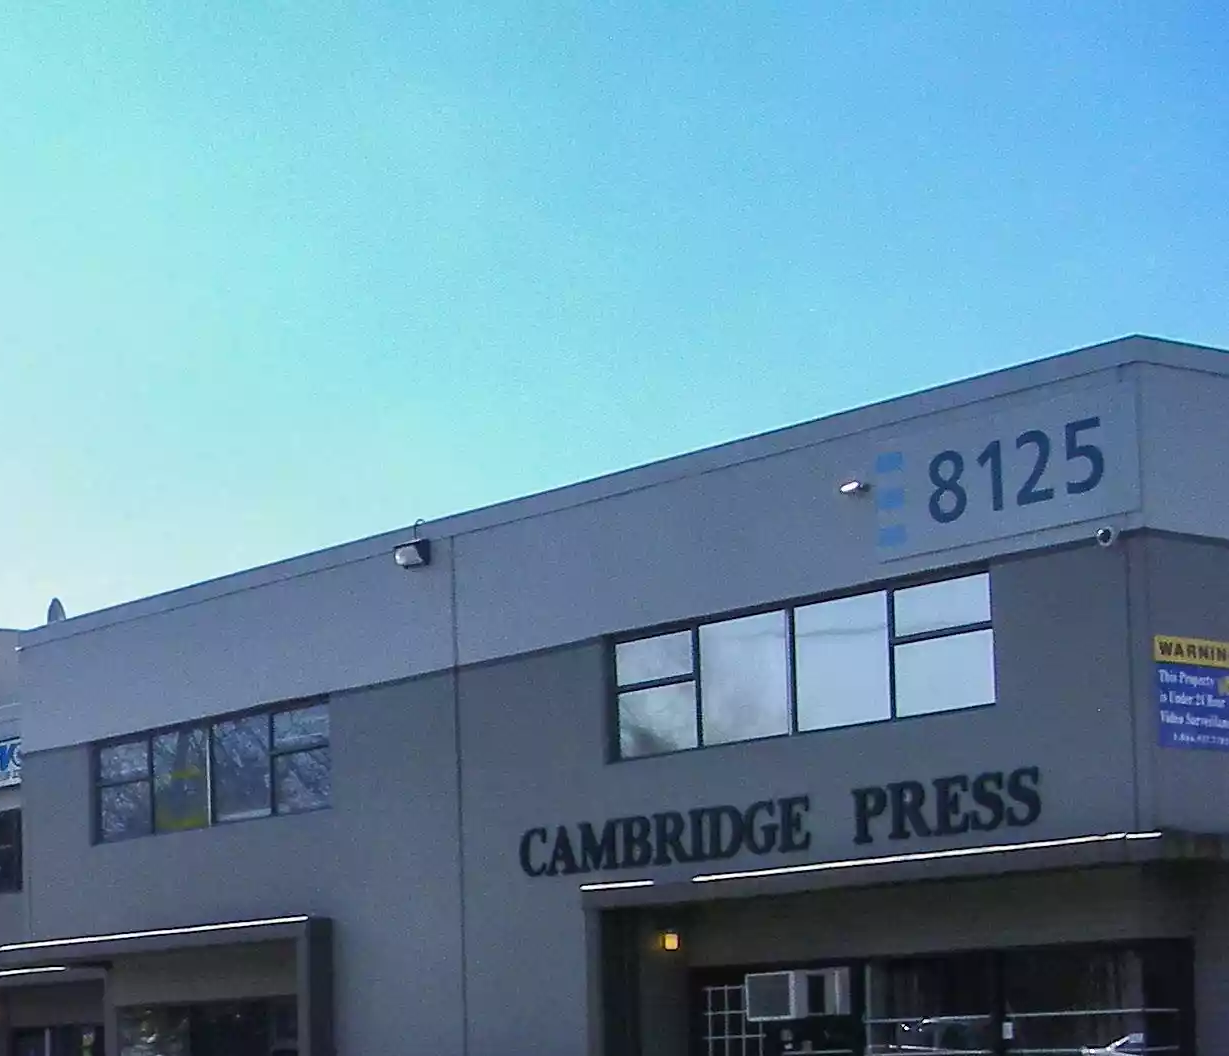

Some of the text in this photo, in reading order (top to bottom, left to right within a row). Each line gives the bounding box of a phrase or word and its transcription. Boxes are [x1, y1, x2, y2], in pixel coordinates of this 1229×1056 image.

[929, 416, 1104, 524] 8125
[518, 766, 1043, 878] CAMBRIDGE PRESS
